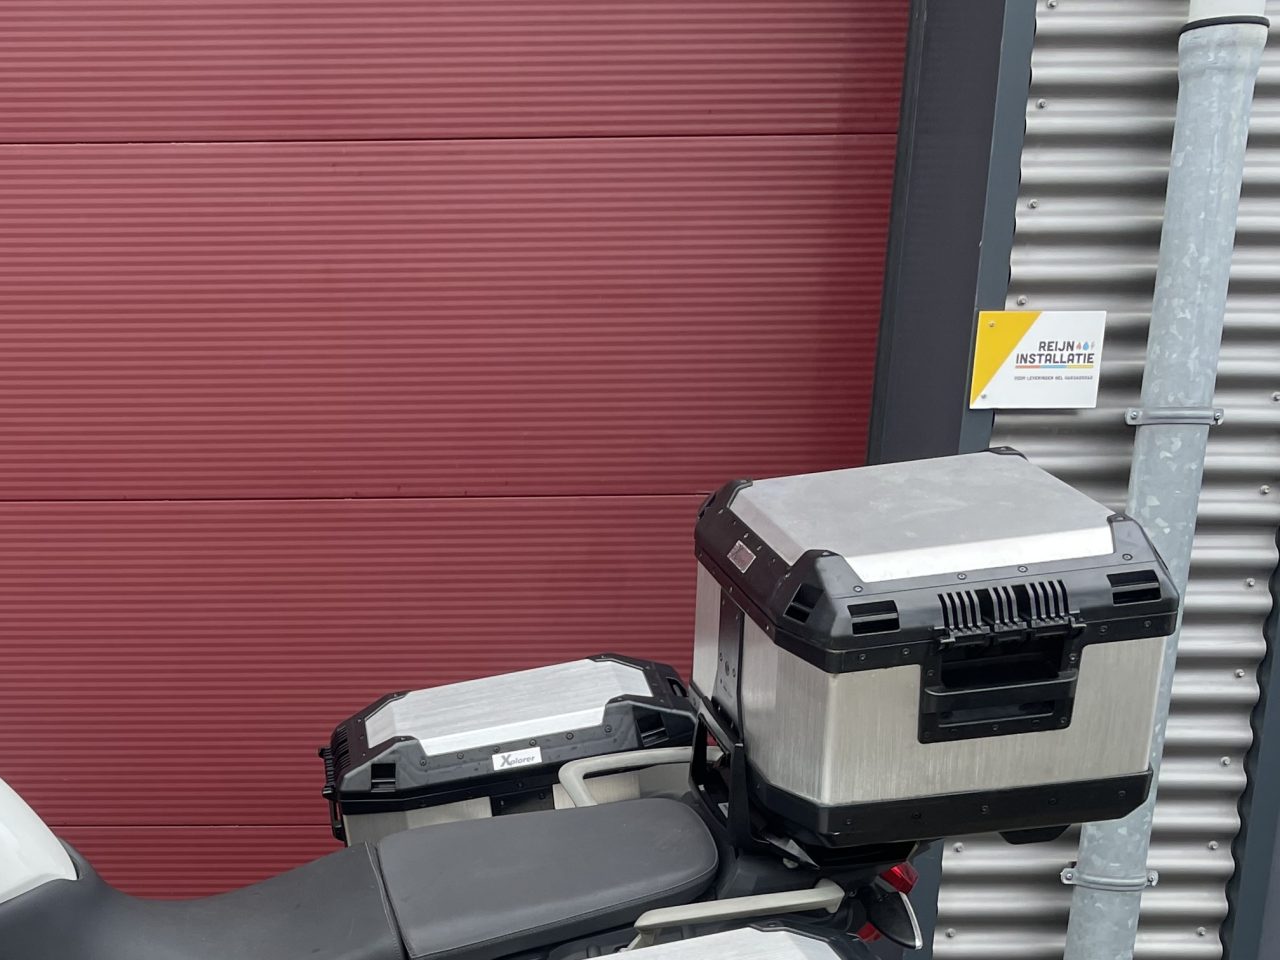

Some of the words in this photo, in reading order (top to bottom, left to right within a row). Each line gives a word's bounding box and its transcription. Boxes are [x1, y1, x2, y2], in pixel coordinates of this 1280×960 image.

[1039, 341, 1074, 352] REIJN
[1015, 353, 1095, 364] INSTALLATIE
[500, 753, 536, 768] Xplorer
